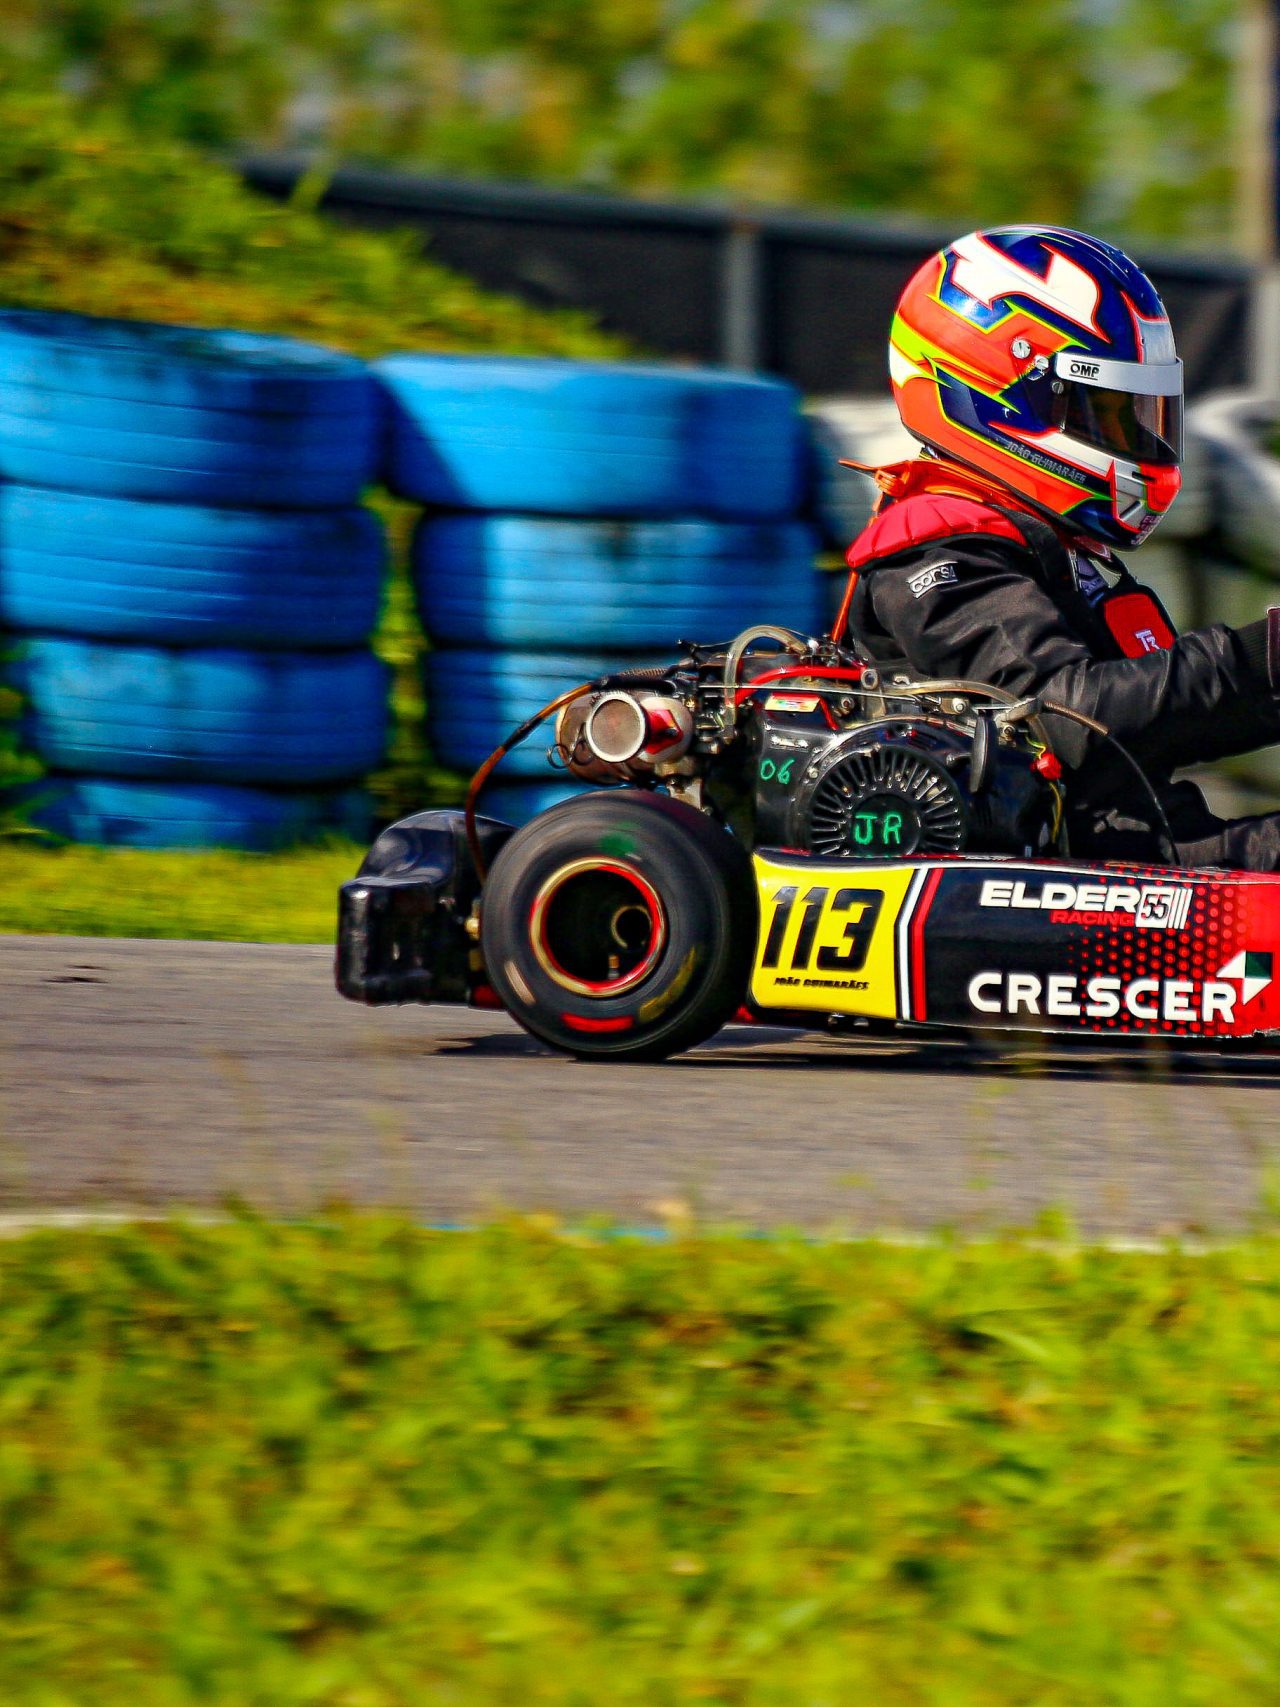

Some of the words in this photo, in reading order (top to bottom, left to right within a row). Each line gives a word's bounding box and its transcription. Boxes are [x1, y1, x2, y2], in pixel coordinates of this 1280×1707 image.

[1070, 363, 1100, 377] OMP
[760, 758, 795, 785] 06
[979, 880, 1142, 913] ELDER
[761, 886, 886, 973] 113
[1050, 910, 1136, 927] RACING
[967, 972, 1238, 1023] CRESCER
